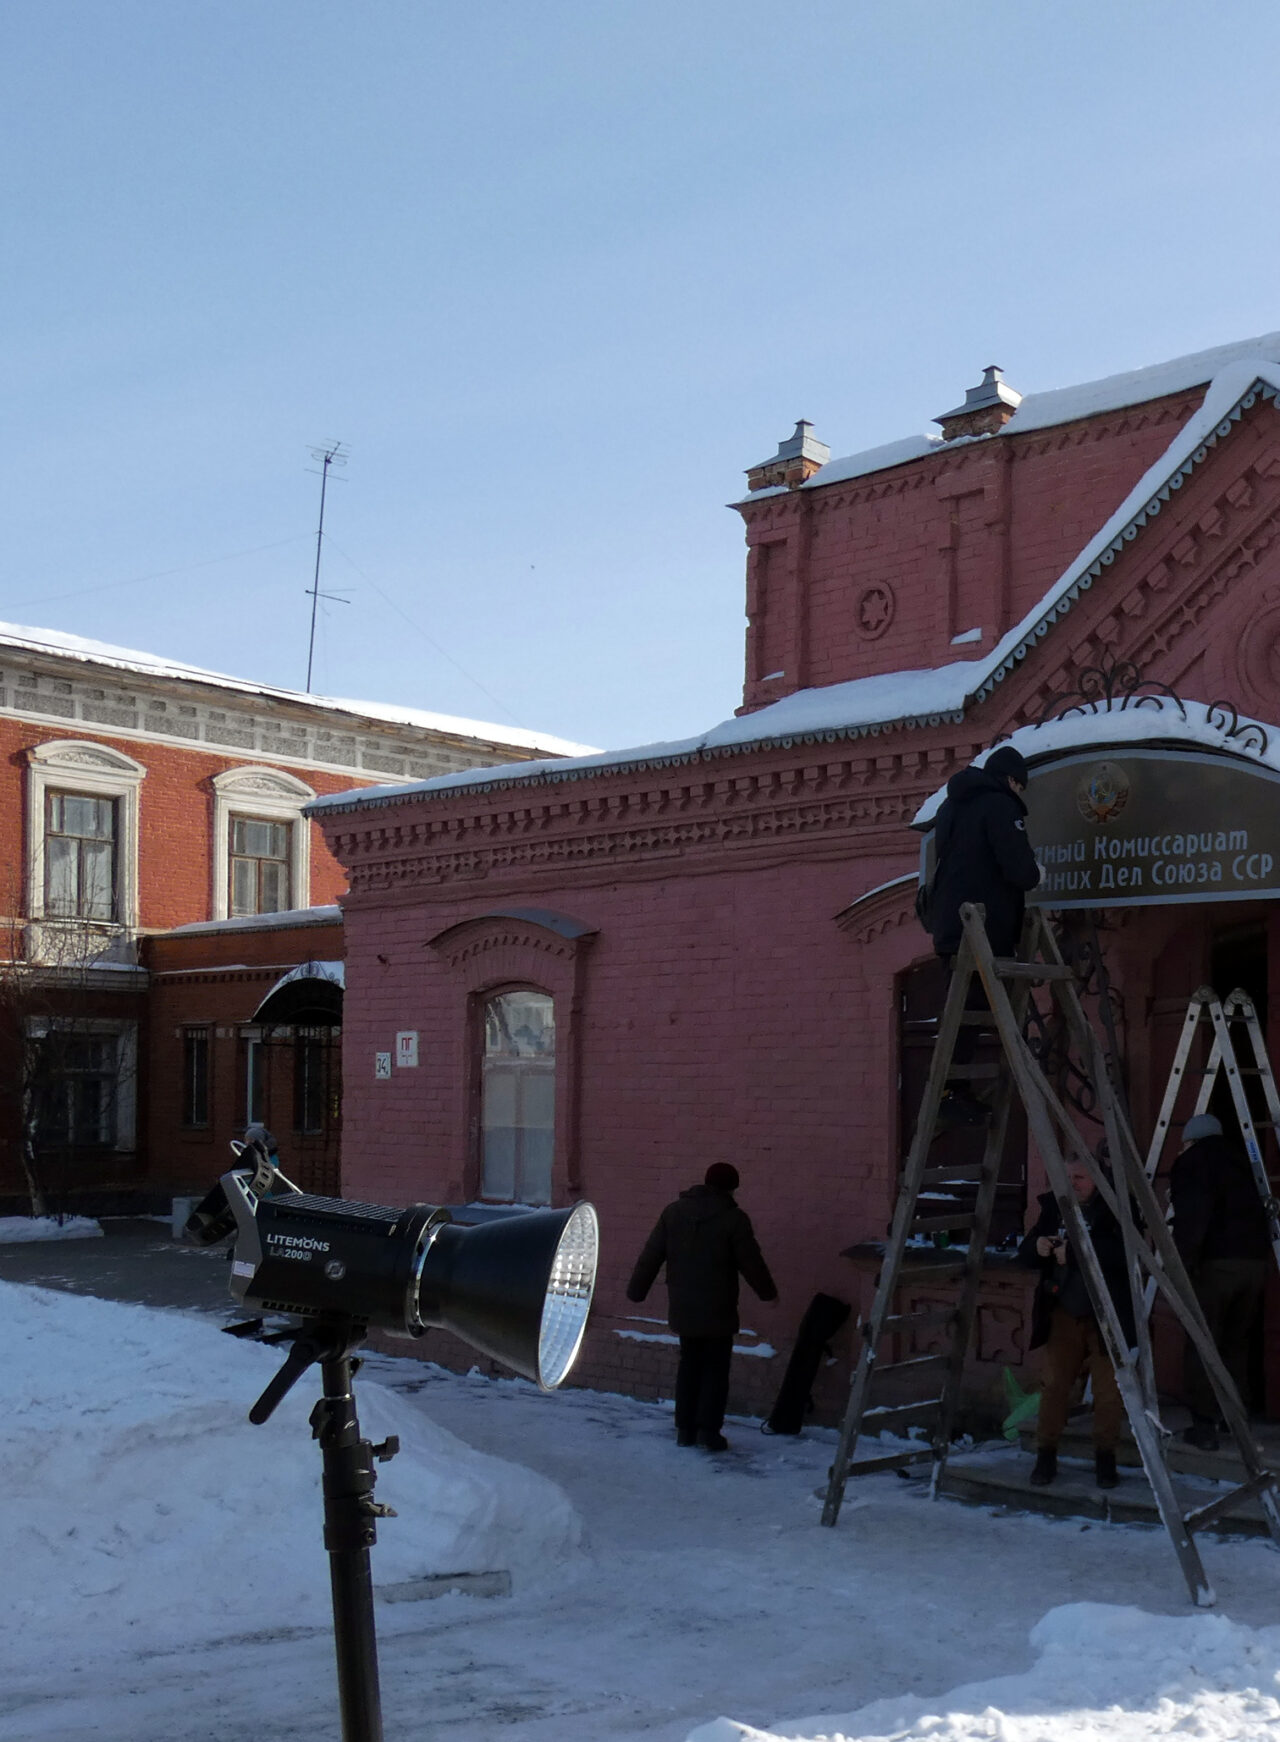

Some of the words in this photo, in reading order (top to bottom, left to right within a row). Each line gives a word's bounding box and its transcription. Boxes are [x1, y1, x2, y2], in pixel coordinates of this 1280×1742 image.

[1034, 840, 1085, 864] дный
[1094, 830, 1248, 861] Комиссариат
[1039, 870, 1092, 893] нних
[1098, 863, 1143, 889] Дел
[1151, 860, 1223, 887] Союза
[1232, 853, 1273, 881] ССР
